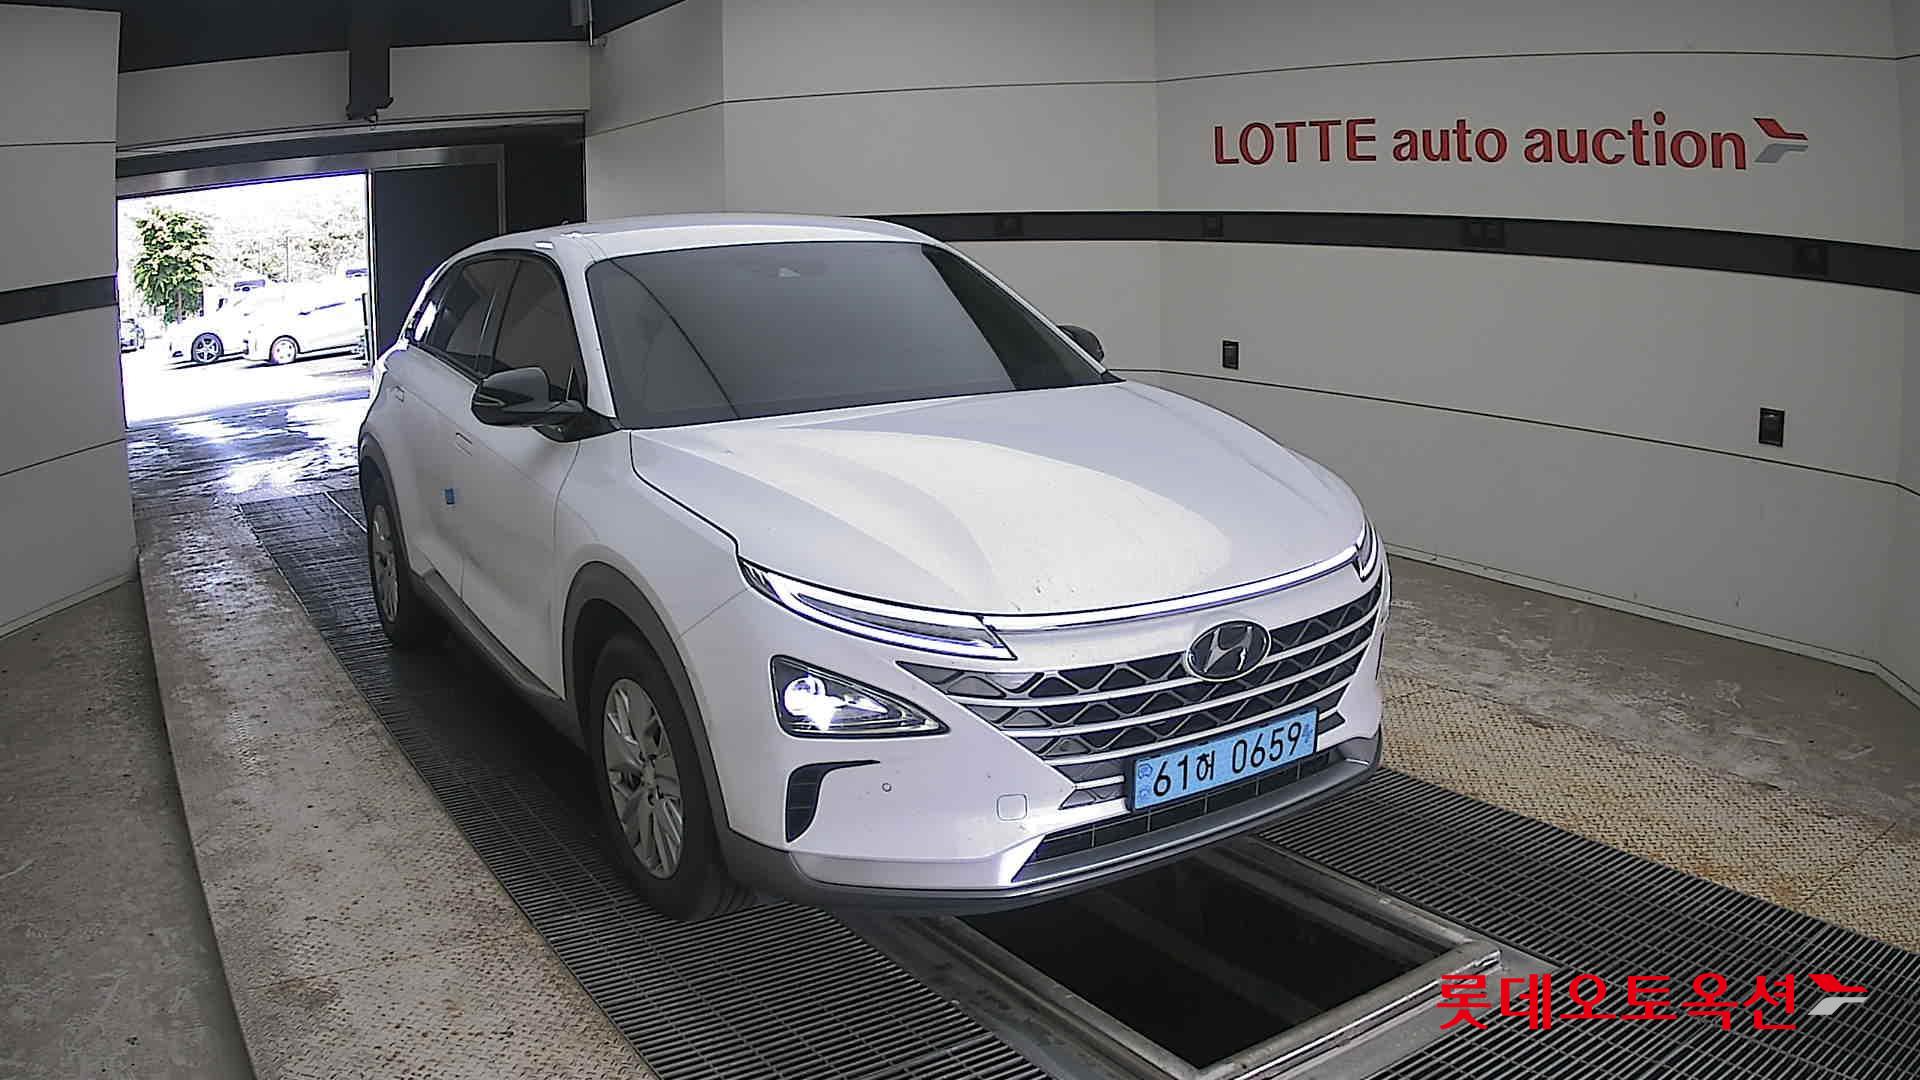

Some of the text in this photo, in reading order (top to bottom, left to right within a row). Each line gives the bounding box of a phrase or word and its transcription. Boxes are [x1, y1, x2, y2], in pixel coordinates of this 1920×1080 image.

[1214, 112, 1746, 170] LOTTE auto auction
[1153, 722, 1303, 797] 61허 0659
